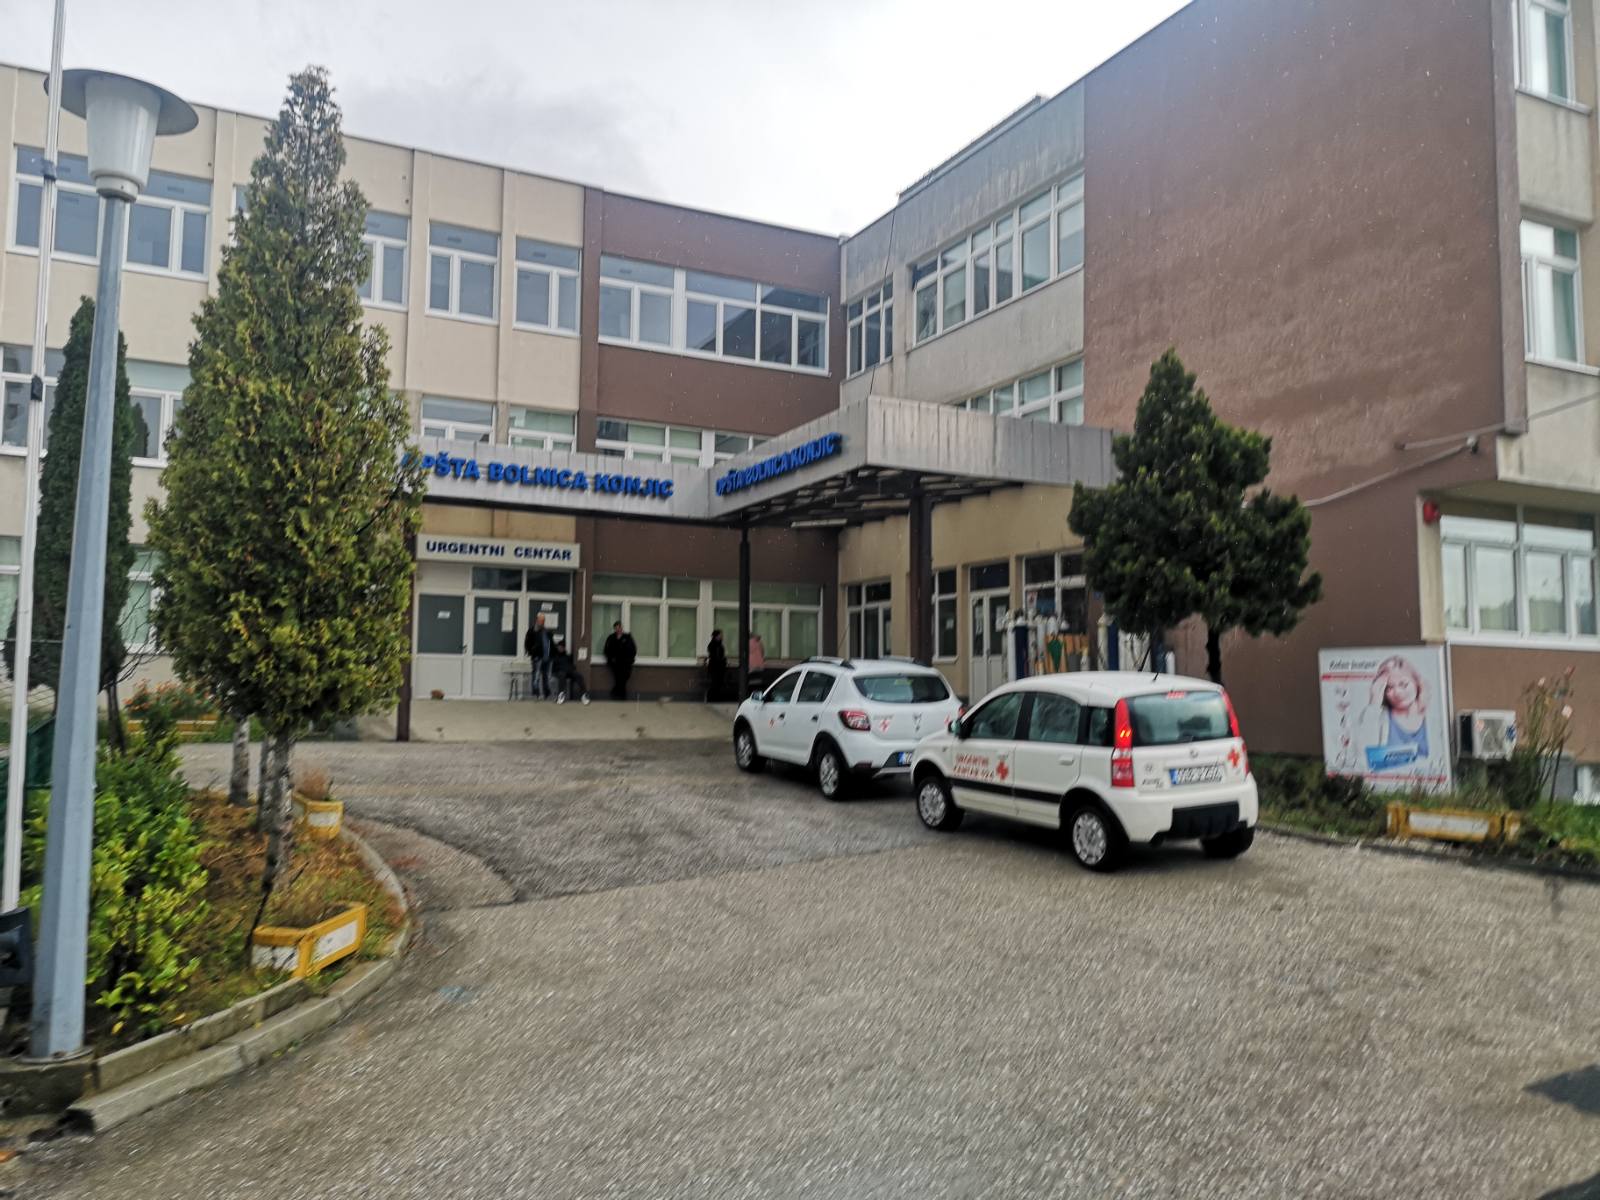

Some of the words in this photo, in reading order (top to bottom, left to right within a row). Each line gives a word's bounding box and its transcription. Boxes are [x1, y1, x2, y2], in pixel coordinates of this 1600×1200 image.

[790, 432, 838, 467] KONJIC
[487, 462, 588, 490] BOLNICA
[595, 473, 674, 498] KONJIC
[426, 541, 505, 556] URGENTNI
[513, 546, 572, 561] CENTAR
